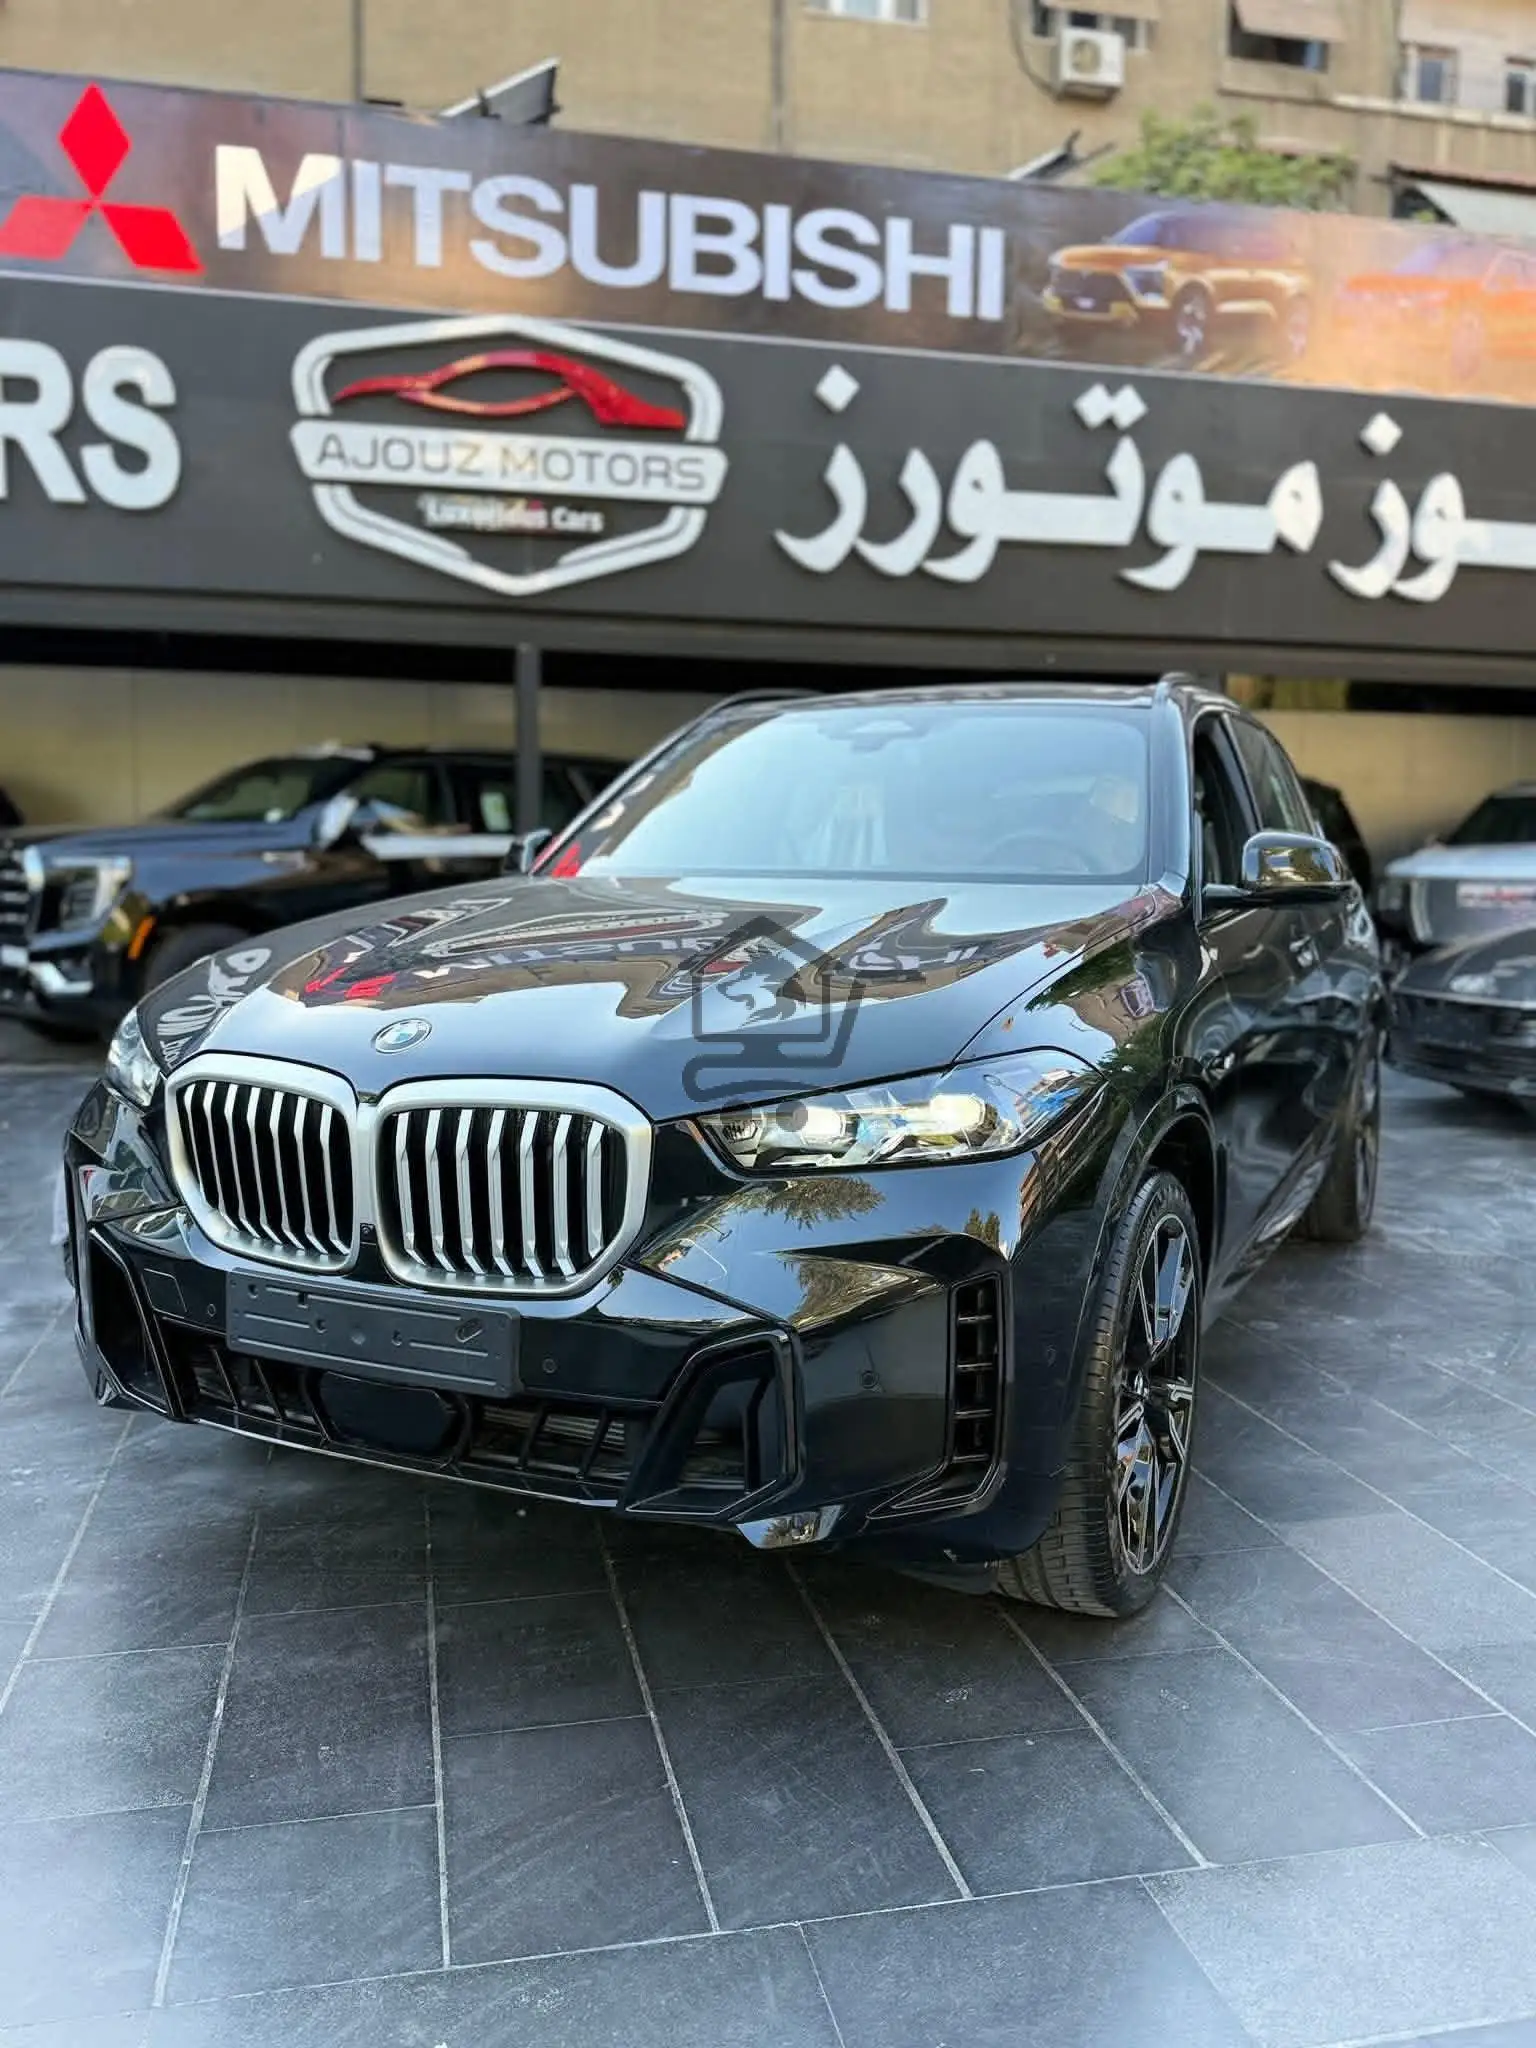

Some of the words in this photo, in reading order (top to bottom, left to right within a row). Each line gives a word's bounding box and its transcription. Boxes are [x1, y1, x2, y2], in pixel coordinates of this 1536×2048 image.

[215, 145, 1004, 320] MITSUBISHI
[316, 433, 483, 477] AJOUZ
[501, 447, 706, 491] MOTORS
[551, 505, 604, 533] Cars
[774, 364, 1323, 591] موتورز
